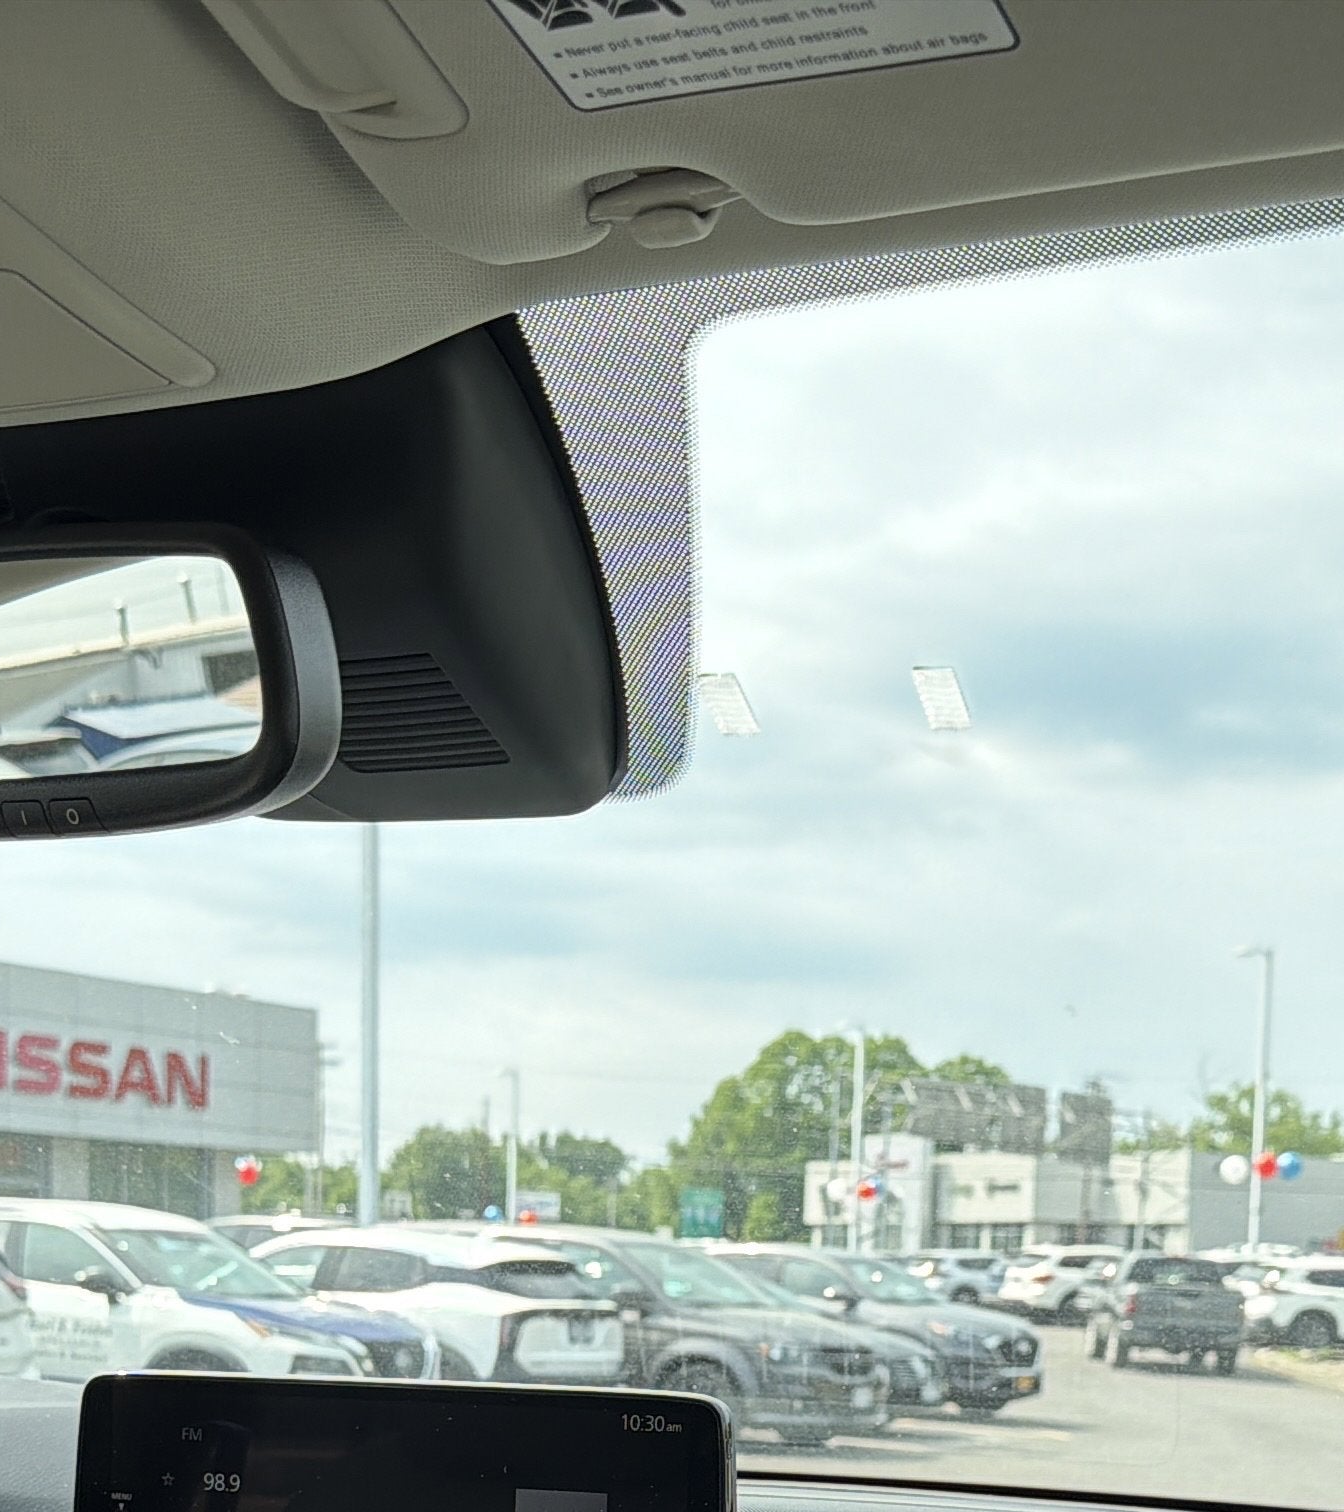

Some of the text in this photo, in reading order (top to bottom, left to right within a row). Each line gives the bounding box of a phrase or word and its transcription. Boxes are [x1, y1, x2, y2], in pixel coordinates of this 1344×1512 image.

[564, 0, 877, 58] Never put a rear-facing child seat in the front
[581, 25, 869, 81] Always use seat belts and child restraints
[596, 31, 989, 98] See owner's manual for more information about air bags
[181, 1427, 203, 1441] FM
[622, 1414, 683, 1432] 10:30 am
[203, 1472, 241, 1492] 98.9
